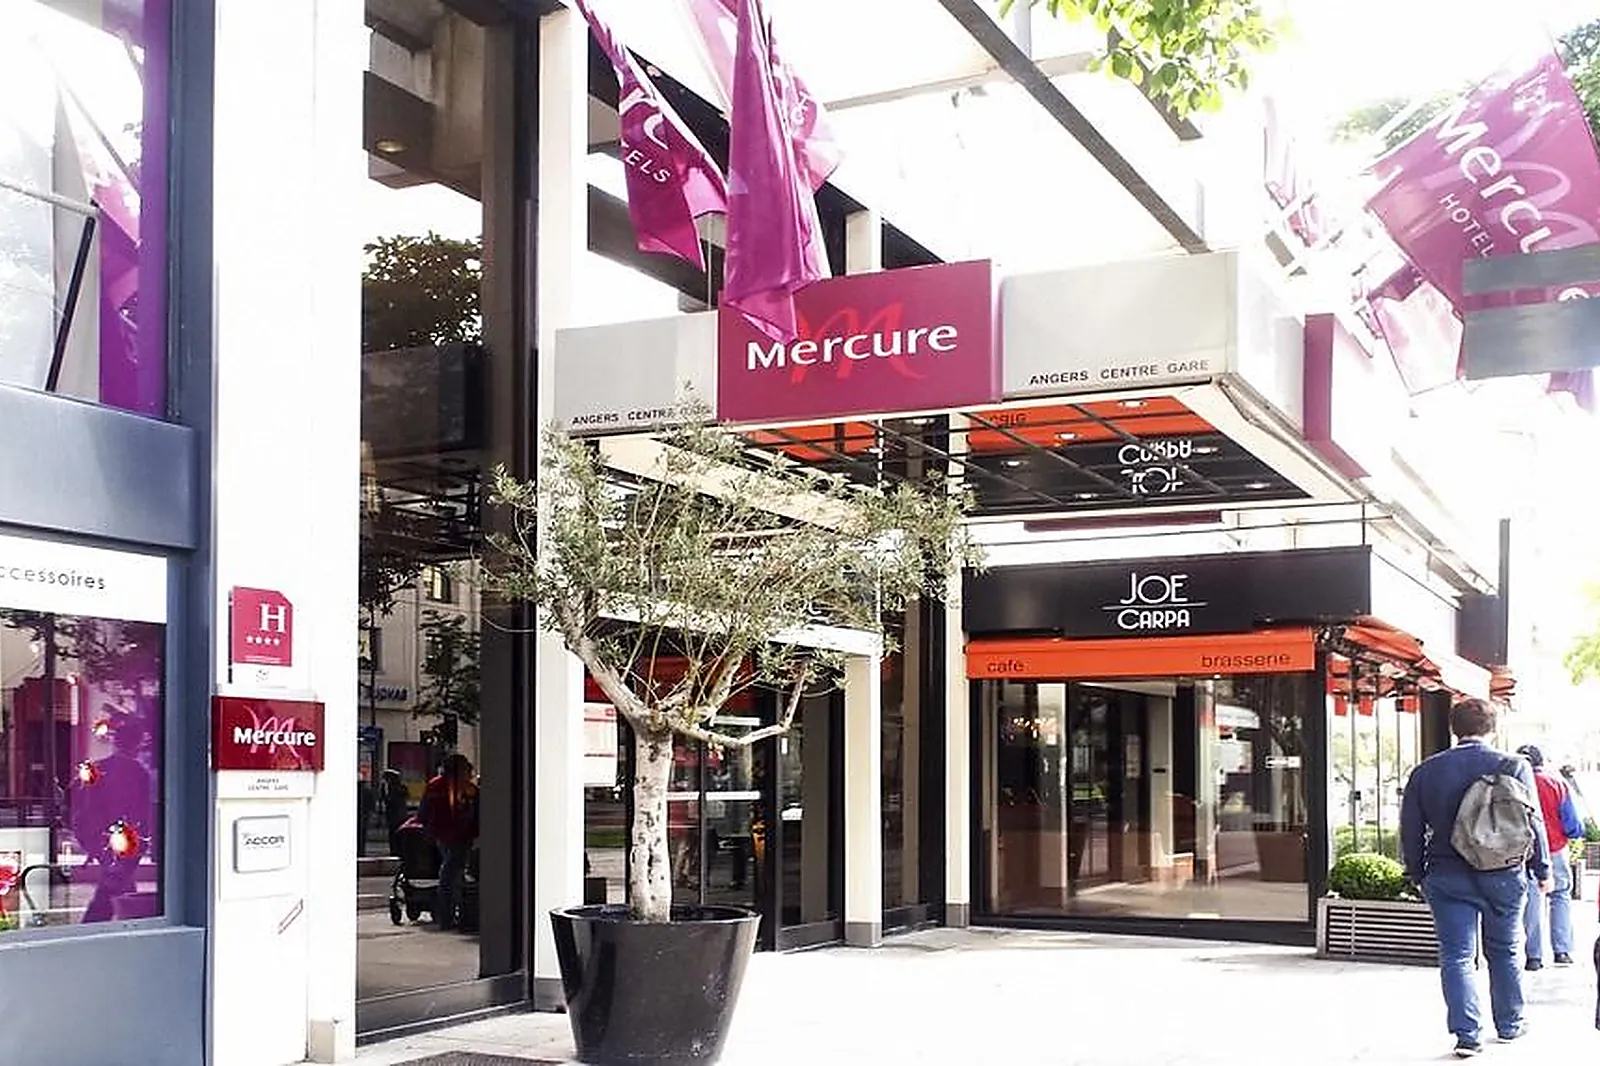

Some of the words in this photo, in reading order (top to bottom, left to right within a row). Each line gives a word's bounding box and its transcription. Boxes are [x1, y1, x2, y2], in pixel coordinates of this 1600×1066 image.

[747, 324, 958, 371] Mercure
[1030, 370, 1089, 385] ANGERS
[1100, 364, 1159, 379] CENTRE
[1167, 359, 1209, 373] GARE
[572, 413, 619, 425] ANGERS
[1120, 573, 1188, 604] JOE
[259, 602, 286, 633] H
[1117, 609, 1190, 630] CARPA
[1201, 654, 1291, 668] brasserie
[233, 726, 316, 747] Mercure
